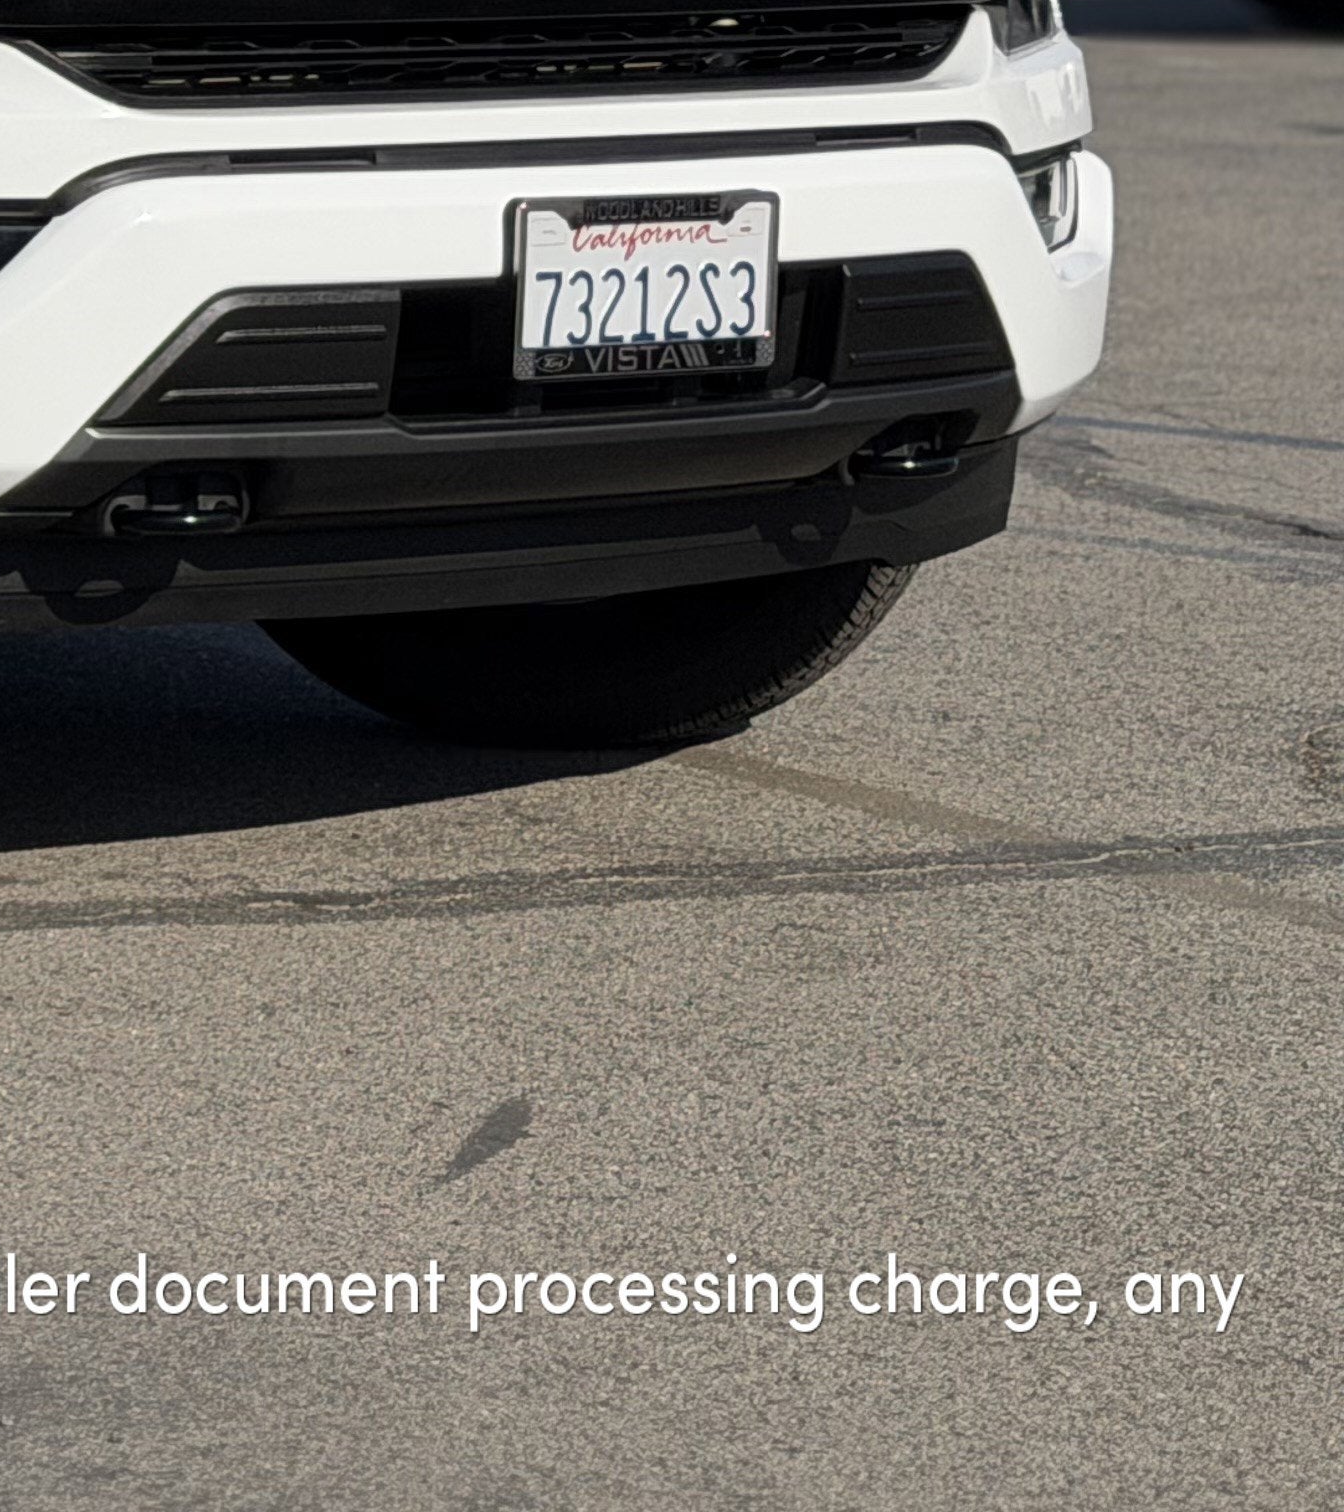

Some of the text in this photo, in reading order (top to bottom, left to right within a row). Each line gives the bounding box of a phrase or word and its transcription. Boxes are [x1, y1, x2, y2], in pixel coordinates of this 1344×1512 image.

[583, 195, 720, 222] WOODLAND HILLS
[571, 221, 728, 261] California
[535, 260, 757, 347] 73212S3
[584, 343, 682, 373] VISTA
